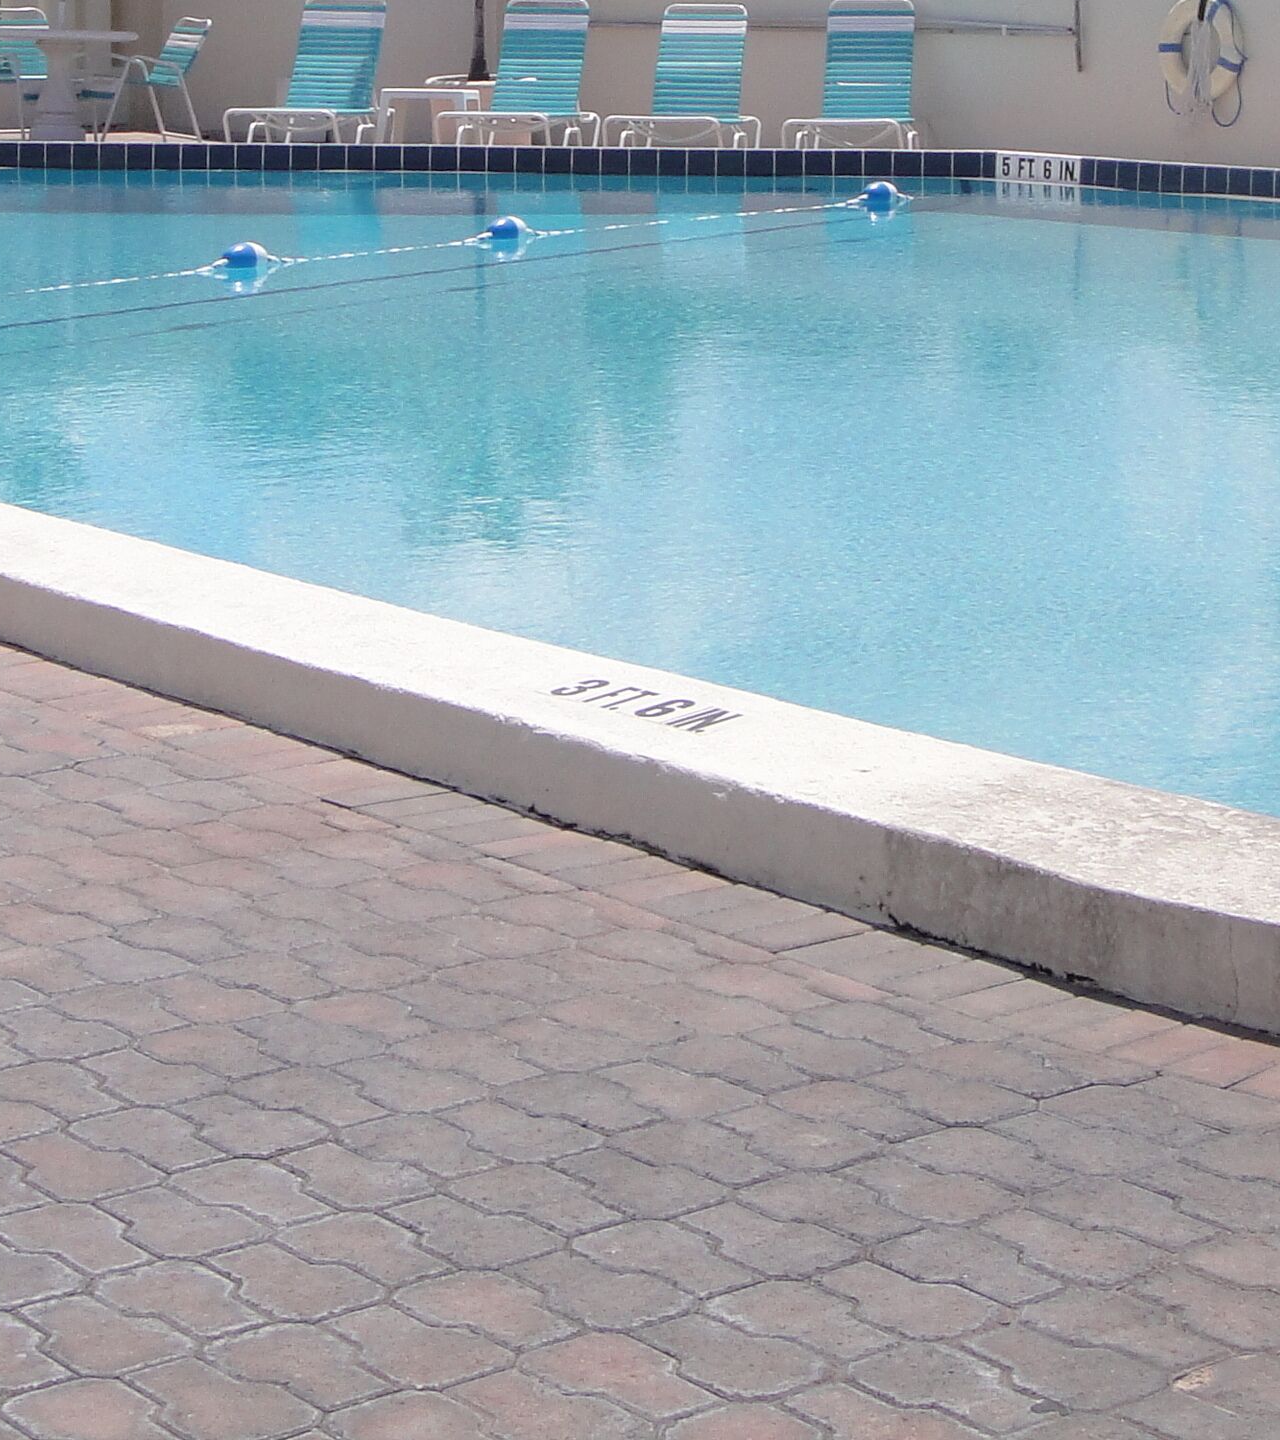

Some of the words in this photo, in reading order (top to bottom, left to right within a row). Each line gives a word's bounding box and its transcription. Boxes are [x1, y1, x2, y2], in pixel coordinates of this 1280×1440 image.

[1002, 157, 1011, 176] 5
[1043, 160, 1051, 179] 6
[1059, 161, 1077, 181] IN.
[550, 679, 610, 696] 3
[634, 699, 695, 718] 6
